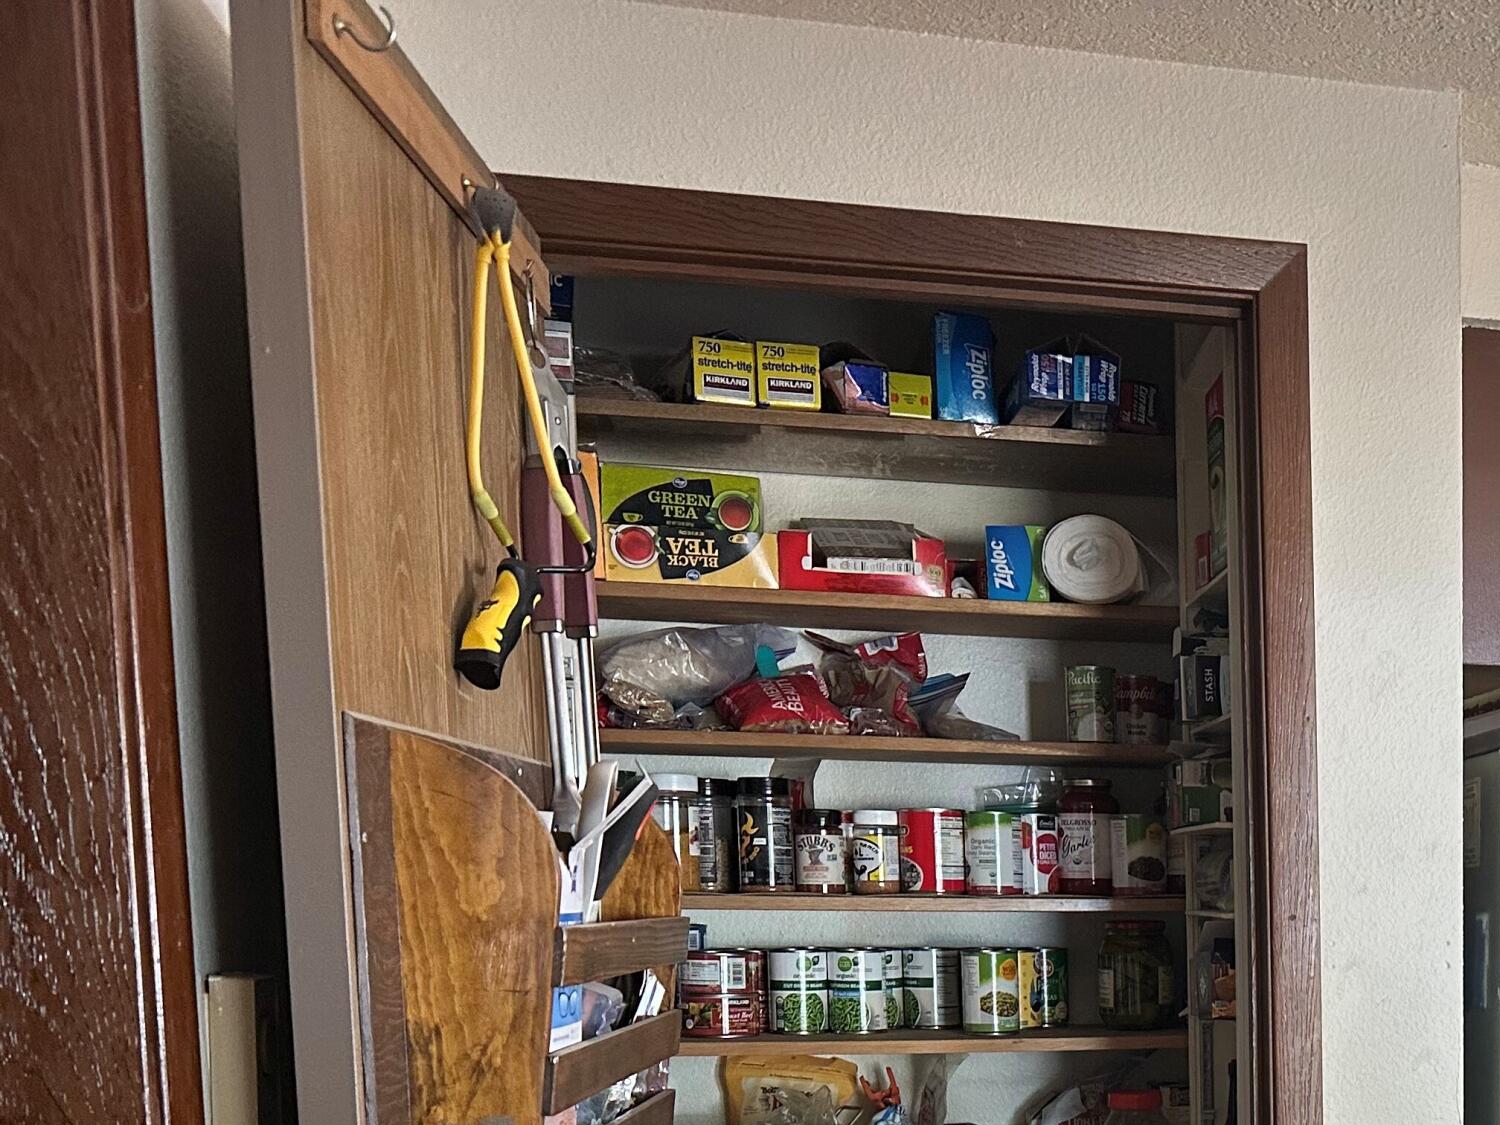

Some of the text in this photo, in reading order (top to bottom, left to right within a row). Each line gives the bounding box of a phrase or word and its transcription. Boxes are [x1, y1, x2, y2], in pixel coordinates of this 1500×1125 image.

[698, 341, 721, 354] 750
[762, 346, 785, 358] 750
[697, 357, 752, 373] stretch-tite
[761, 362, 817, 376] stretch-tite
[705, 375, 748, 387] KIRKLAND
[966, 348, 988, 400] Ziploc
[770, 380, 812, 390] KIRKLAND
[648, 490, 712, 507] GREEN
[661, 504, 699, 520] TEA
[666, 537, 719, 556] TEA
[666, 554, 719, 568] BLACK
[994, 539, 1016, 591] Ziploc
[1068, 671, 1102, 685] Pacific
[1204, 668, 1214, 702] STASH
